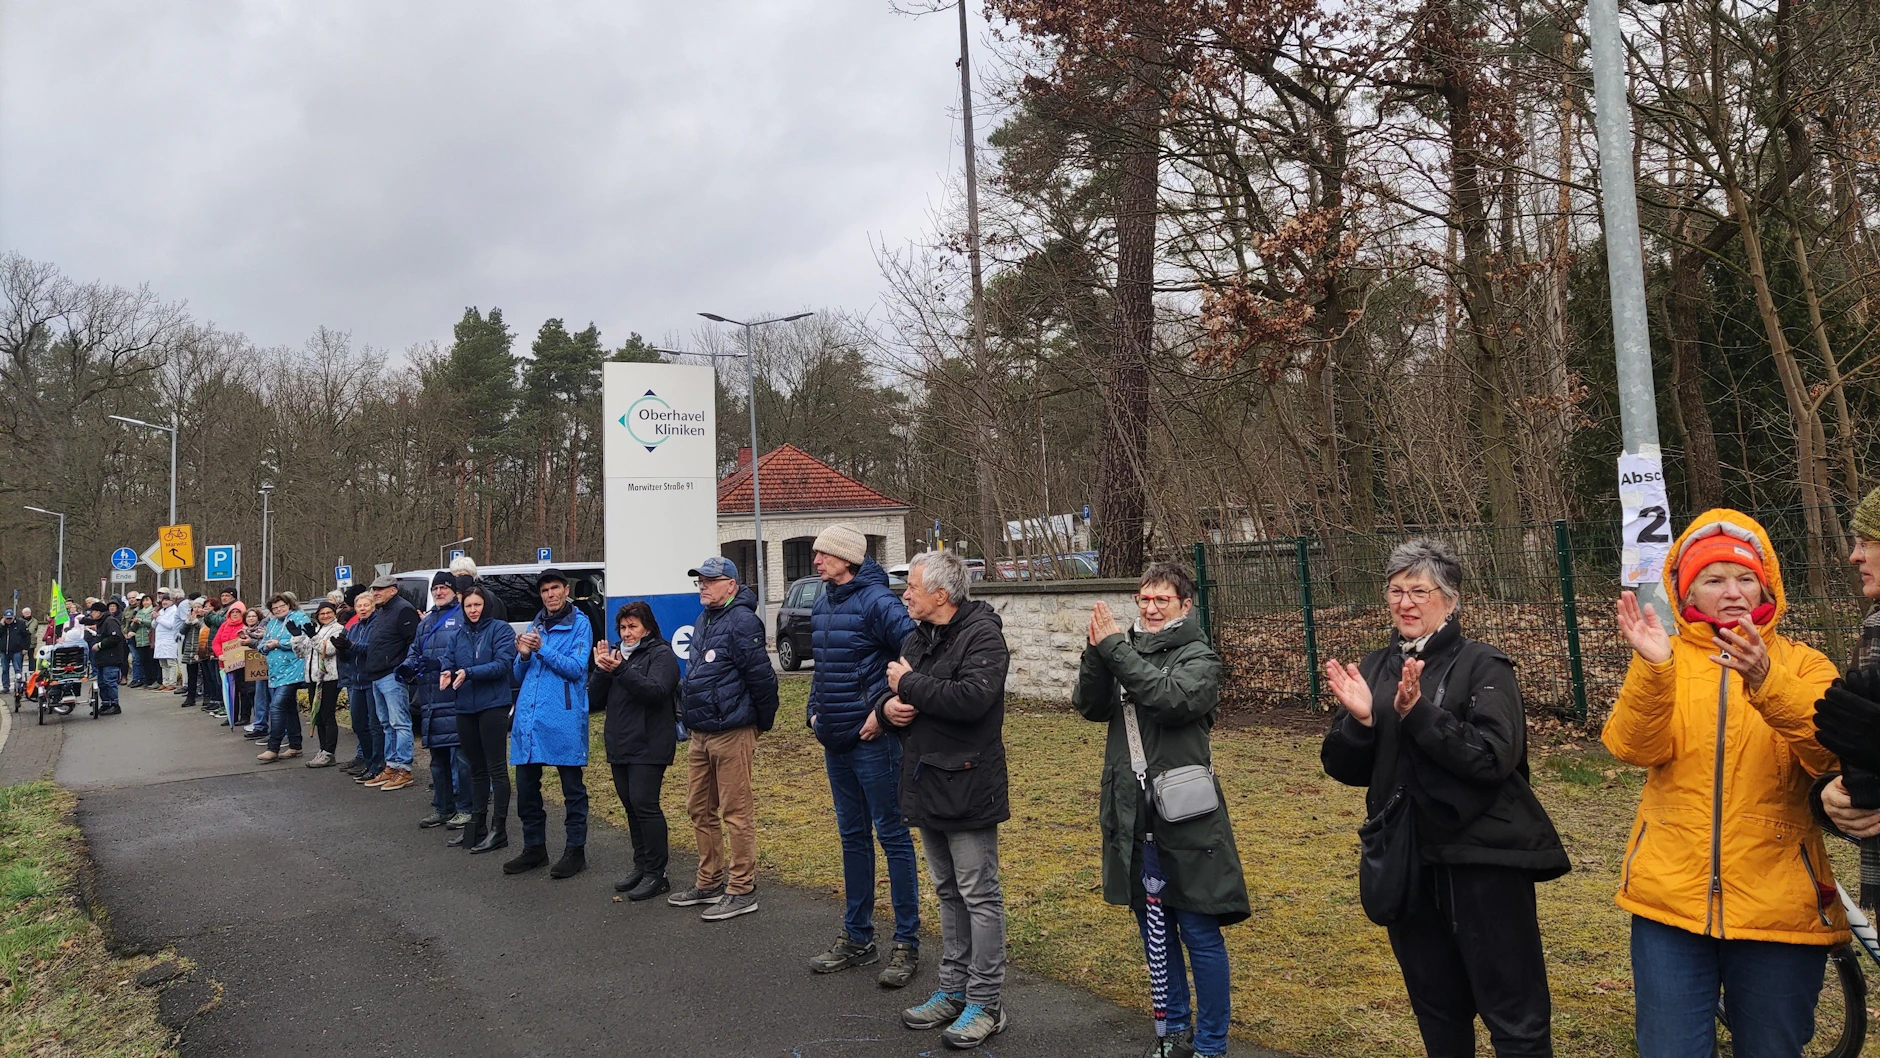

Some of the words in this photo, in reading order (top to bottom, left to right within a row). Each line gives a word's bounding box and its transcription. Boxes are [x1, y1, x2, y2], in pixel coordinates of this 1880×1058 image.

[639, 409, 705, 422] Oberhavel
[655, 424, 705, 436] Kliniken
[1620, 471, 1662, 486] Absc
[627, 483, 662, 491] Marwitzer
[663, 481, 685, 491] Straße
[686, 481, 694, 490] 91
[1637, 505, 1669, 543] 2
[214, 551, 228, 568] P
[541, 549, 549, 560] P
[339, 568, 348, 579] P
